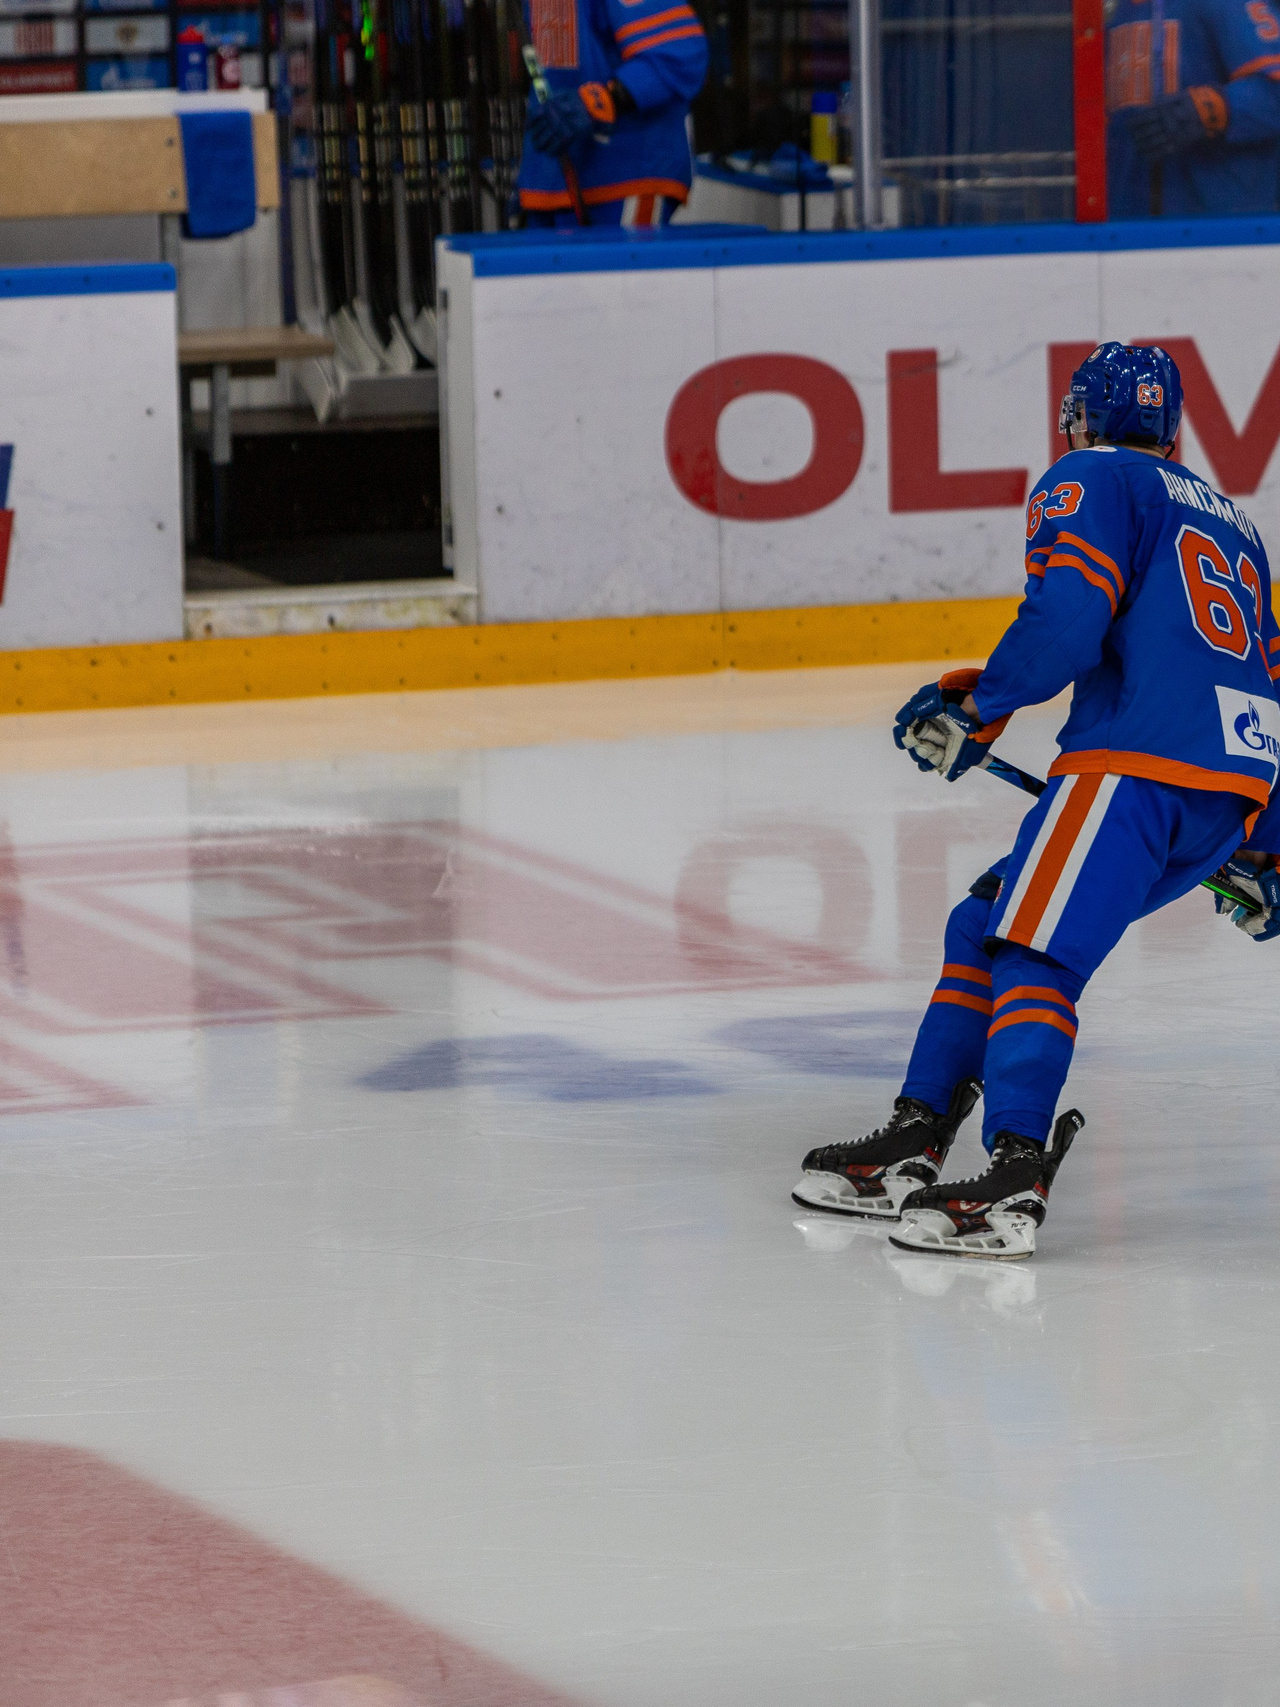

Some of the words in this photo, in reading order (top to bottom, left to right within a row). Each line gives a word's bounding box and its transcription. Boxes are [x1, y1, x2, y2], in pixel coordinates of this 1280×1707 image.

[1137, 383, 1164, 407] 63
[1026, 482, 1085, 540] 63
[1227, 862, 1254, 878] CCM
